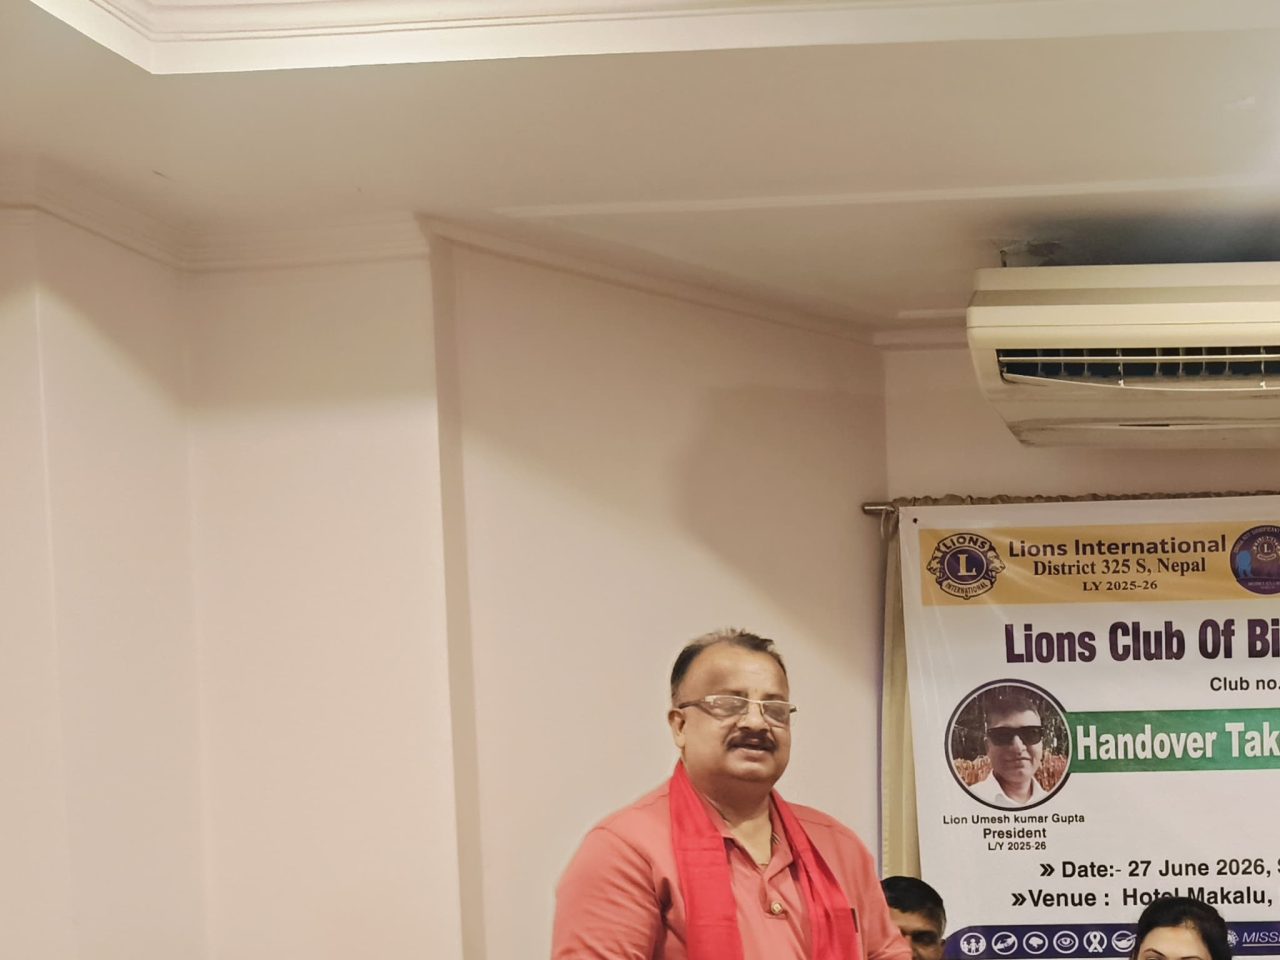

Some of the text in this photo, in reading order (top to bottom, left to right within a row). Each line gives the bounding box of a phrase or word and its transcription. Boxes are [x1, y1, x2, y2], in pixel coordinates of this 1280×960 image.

[942, 536, 988, 550] LIONS
[1008, 540, 1068, 558] Lions
[1075, 535, 1226, 556] International
[958, 554, 976, 576] L
[1034, 558, 1206, 576] District 325 S, Nepal
[945, 582, 988, 594] INTERNATIONAL
[1082, 580, 1158, 592] LY 2025-26
[1004, 624, 1096, 663] Lions
[1108, 621, 1186, 662] Club
[1199, 618, 1235, 659] Of
[1210, 676, 1250, 691] Club
[1077, 723, 1217, 761] Handover
[943, 814, 1085, 825] Lion Umesh kumar Gupta
[984, 828, 1046, 839] President
[988, 841, 1046, 850] L/Y 2025-26
[1128, 860, 1152, 876] 27
[1158, 860, 1209, 876] June
[1216, 858, 1271, 878] 2026,
[1028, 890, 1096, 908] Venue
[1187, 885, 1272, 906] Makalu,
